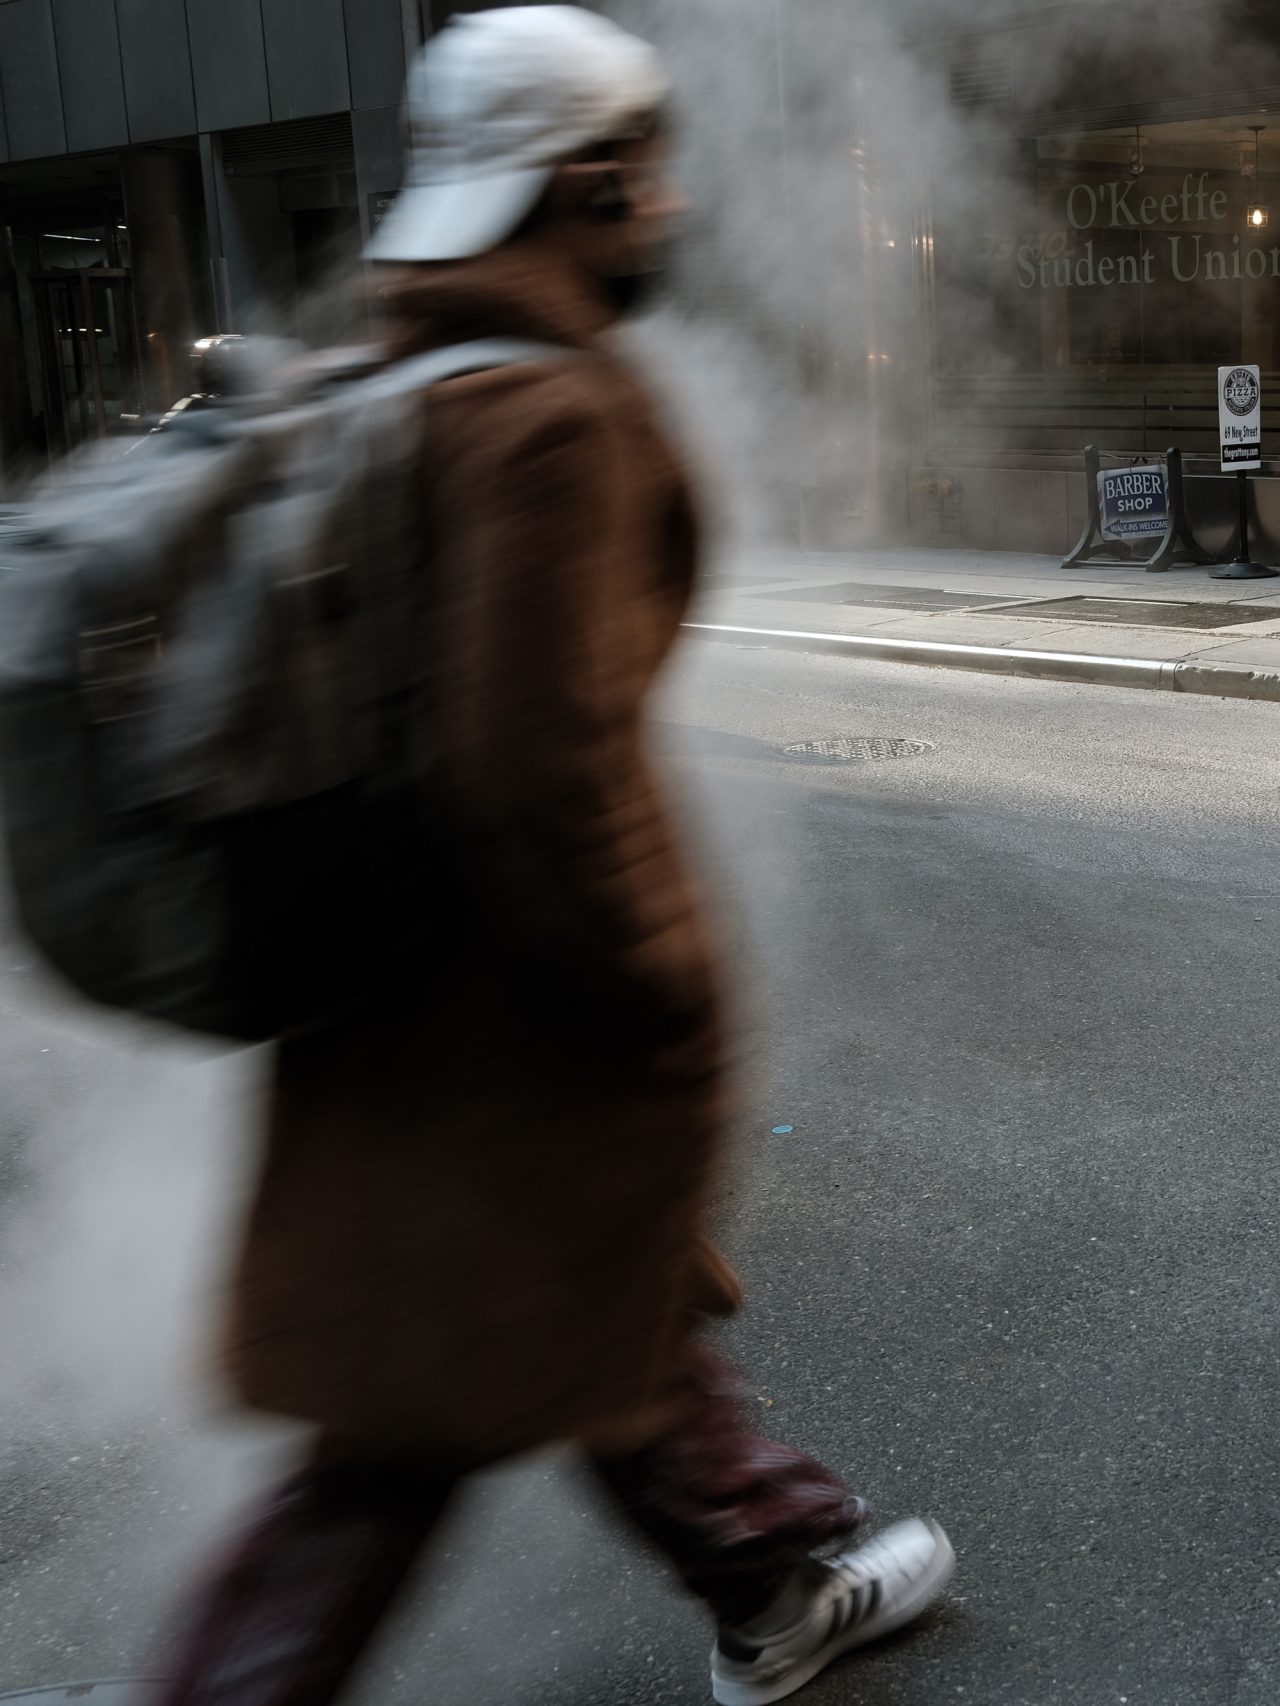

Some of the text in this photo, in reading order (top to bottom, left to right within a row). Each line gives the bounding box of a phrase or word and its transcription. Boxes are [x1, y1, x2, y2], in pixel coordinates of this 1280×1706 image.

[1066, 172, 1228, 230] O'Keeffe
[1017, 240, 1155, 289] Student
[1226, 387, 1256, 397] PIZZA
[1224, 425, 1258, 439] 69 New Street
[1105, 474, 1162, 499] BARBER
[1117, 497, 1153, 512] SHOP
[1110, 521, 1168, 533] WALK-INS WELCOME
